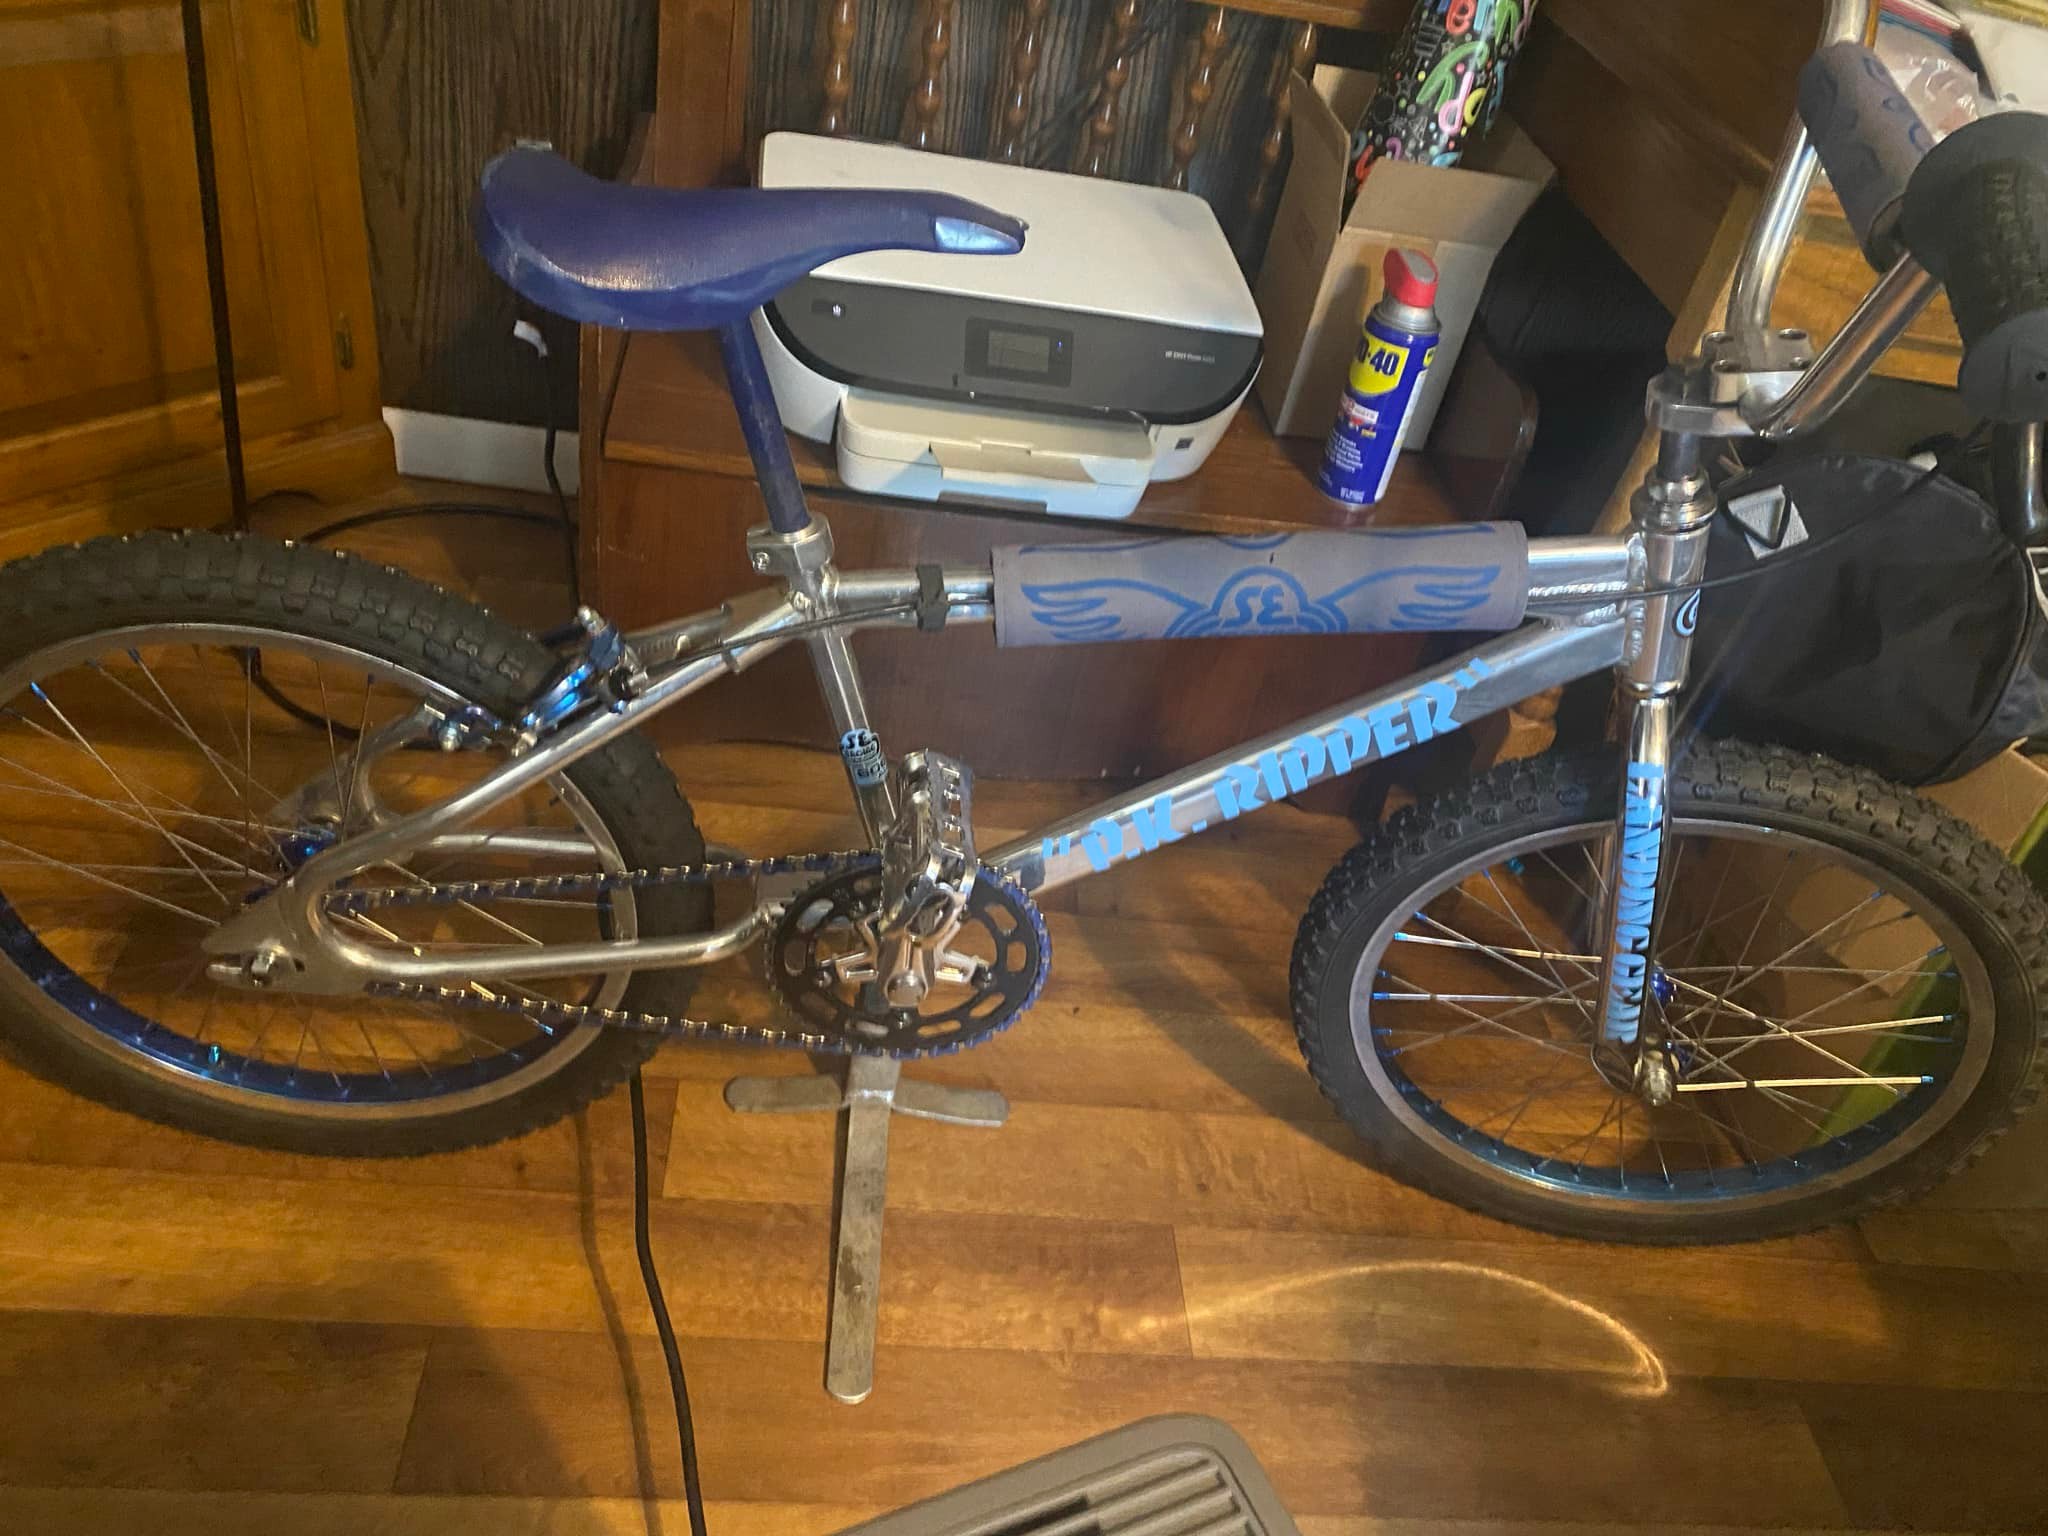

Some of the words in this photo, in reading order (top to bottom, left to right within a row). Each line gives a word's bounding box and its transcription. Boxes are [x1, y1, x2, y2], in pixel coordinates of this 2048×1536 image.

[1356, 338, 1400, 376] D-40
[1222, 584, 1295, 626] SE
[1615, 761, 1664, 953] LANDING
[1605, 953, 1646, 1043] GEAR
